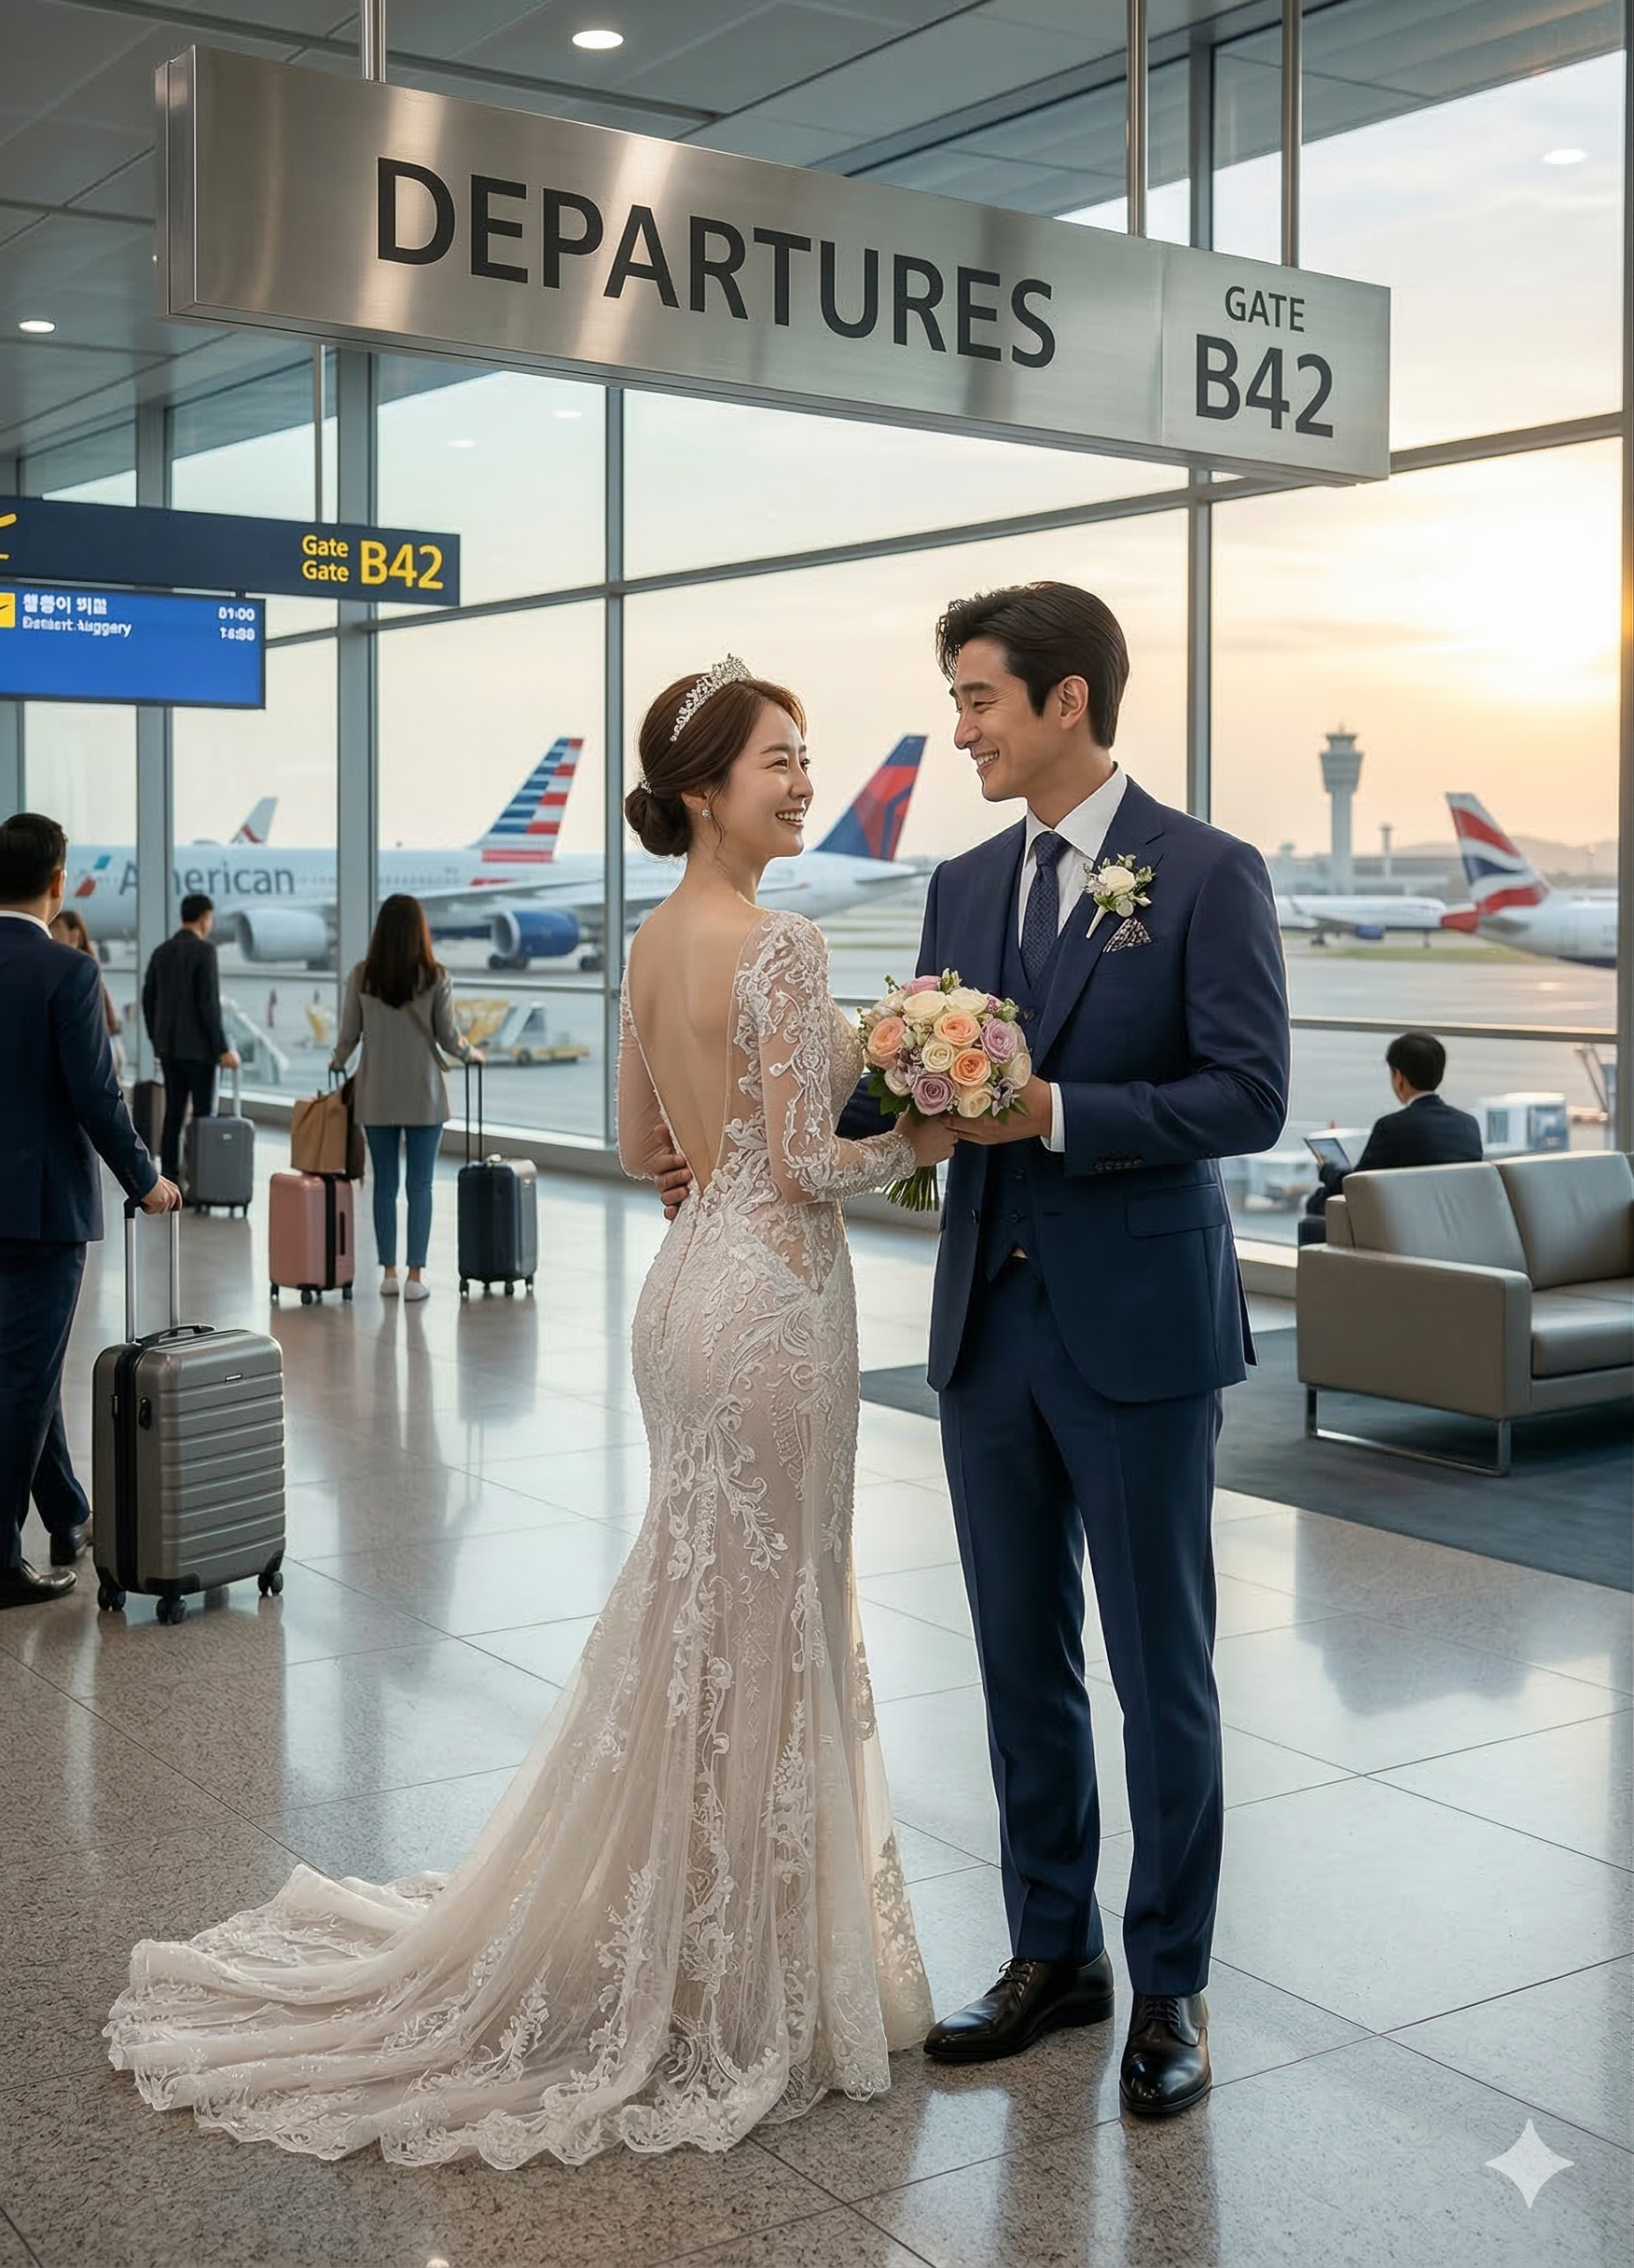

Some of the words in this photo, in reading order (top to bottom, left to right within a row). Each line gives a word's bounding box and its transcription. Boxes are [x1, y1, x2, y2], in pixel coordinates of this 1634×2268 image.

[376, 157, 1056, 369] DEPARTURES
[1225, 285, 1306, 333] GATE
[1195, 333, 1335, 439] B42
[301, 534, 349, 558] Gate
[359, 539, 444, 590] B42
[301, 560, 350, 583] Gate
[118, 858, 296, 896] Aerican
